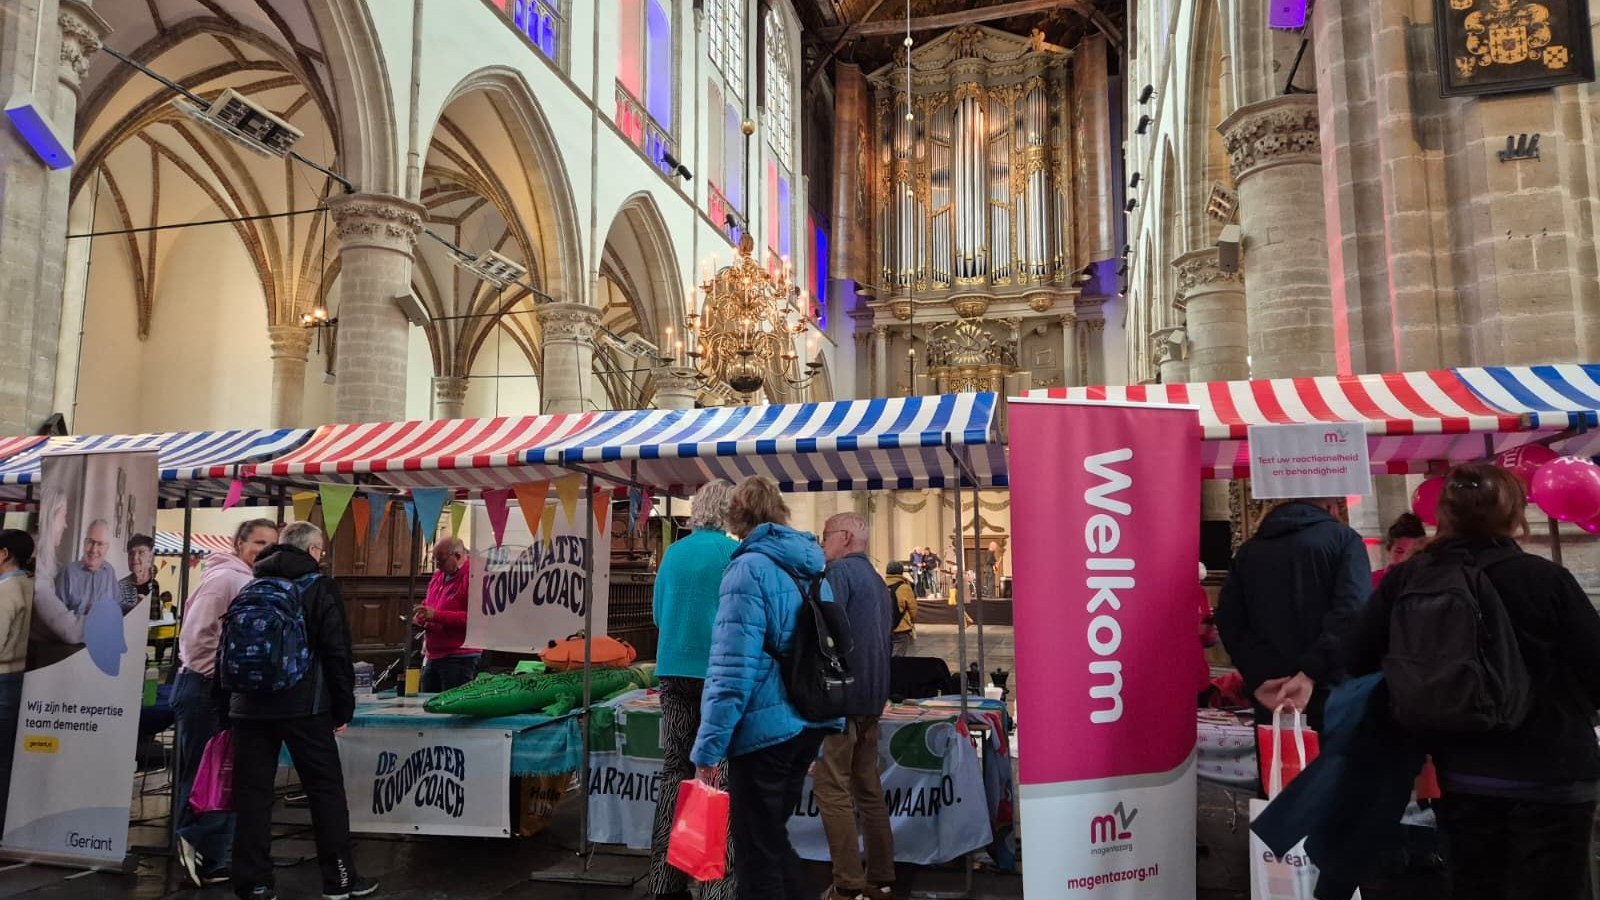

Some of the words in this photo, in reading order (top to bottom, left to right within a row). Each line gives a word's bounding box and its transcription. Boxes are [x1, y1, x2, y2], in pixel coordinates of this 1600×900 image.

[1258, 456, 1275, 465] Test
[1292, 453, 1359, 463] reactiesnelheid
[1084, 447, 1136, 724] Welkom
[27, 701, 43, 714] Wij
[44, 702, 60, 714] zijn
[62, 702, 77, 714] het
[80, 704, 124, 717] expertise
[25, 719, 51, 728] team
[53, 719, 98, 732] dementie
[375, 750, 398, 776] DE
[372, 745, 465, 815] KOUDWATER
[414, 773, 465, 818] COACH
[70, 832, 113, 851] Geriant
[1090, 843, 1133, 856] magentazorg
[1067, 862, 1159, 890] magentazorg.nl
